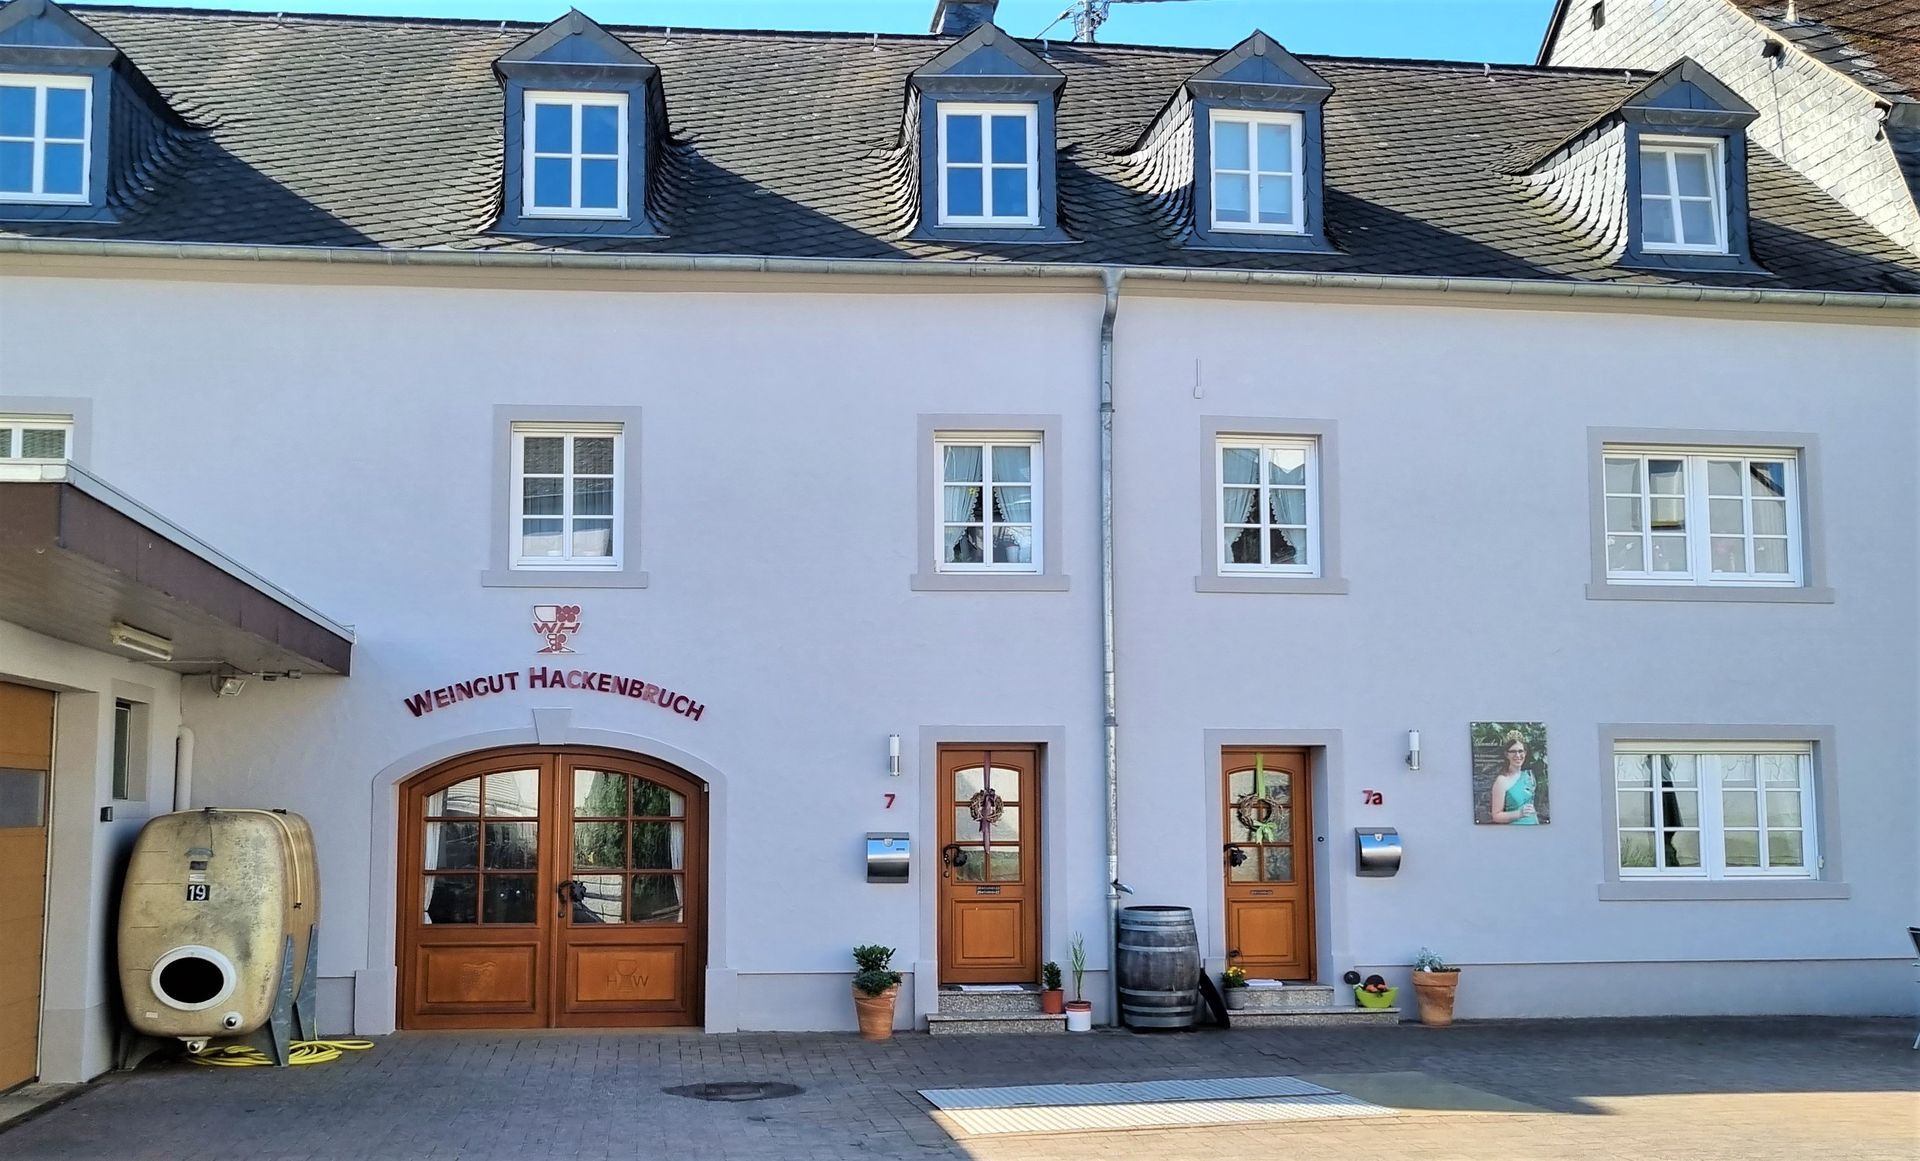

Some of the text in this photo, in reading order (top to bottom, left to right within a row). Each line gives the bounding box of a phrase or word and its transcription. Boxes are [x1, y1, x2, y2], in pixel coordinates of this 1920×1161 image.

[533, 622, 581, 634] WH
[404, 666, 705, 722] WEINGUT HACKENBRUCH
[884, 793, 896, 809] 7
[1362, 789, 1383, 805] 7a
[189, 885, 207, 901] 19
